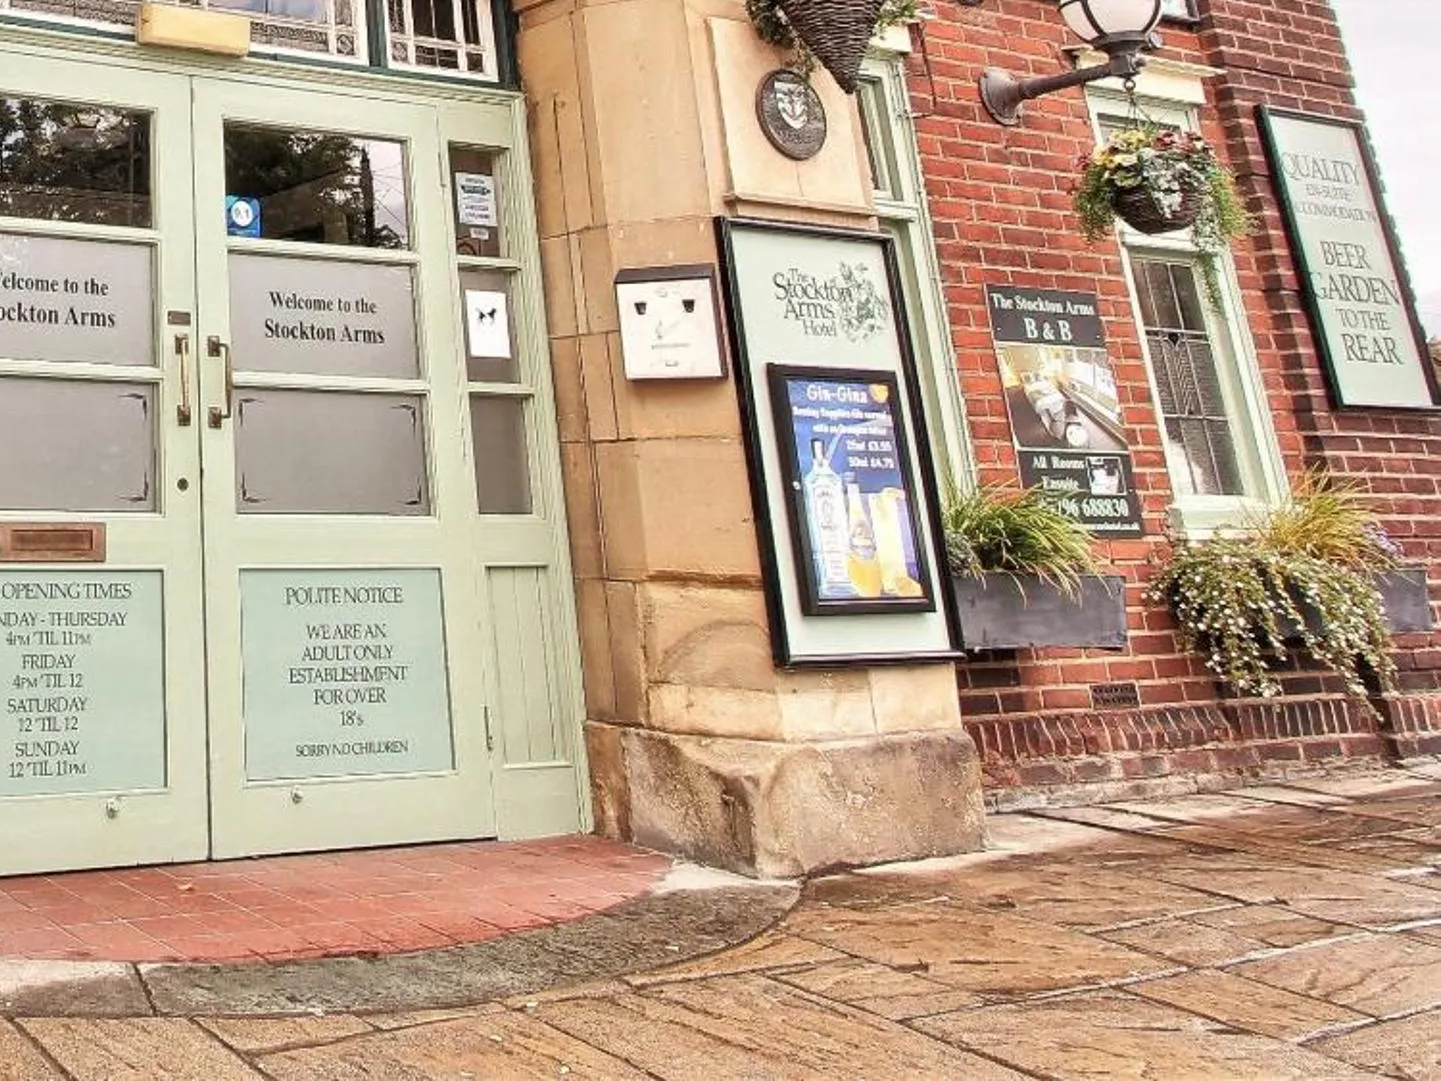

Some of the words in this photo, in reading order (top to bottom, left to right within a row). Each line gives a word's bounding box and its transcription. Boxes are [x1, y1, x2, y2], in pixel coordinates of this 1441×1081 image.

[1281, 152, 1360, 186] QUALITY
[1320, 240, 1372, 269] BEER
[788, 267, 808, 282] The
[63, 274, 78, 294] to
[84, 277, 109, 296] the
[772, 271, 854, 302] Stockton
[1310, 272, 1400, 306] GARDEN
[268, 291, 333, 312] Welcome
[337, 297, 352, 313] to
[355, 297, 377, 314] the
[784, 298, 836, 321] Arms
[990, 292, 1013, 309] The
[1014, 295, 1064, 313] Stockton
[1066, 300, 1096, 316] Arms
[64, 308, 116, 328] Arms
[1335, 308, 1358, 329] TO
[1357, 310, 1391, 331] THE
[264, 318, 335, 341] Stockton
[340, 324, 385, 345] Arms
[802, 319, 837, 337] Hotel
[1024, 317, 1038, 339] B
[1043, 322, 1056, 340] &
[1057, 319, 1073, 341] B
[1341, 333, 1405, 365] REAR
[1, 582, 80, 600] OPENING
[83, 583, 132, 599] TIMES
[285, 587, 341, 605] POLITE
[343, 586, 404, 604] NOTICE
[48, 611, 128, 627] THURSDAY
[306, 624, 331, 639] WE
[333, 623, 362, 639] ARE
[364, 623, 387, 639] AN
[22, 653, 76, 670] FRIDAY
[302, 644, 352, 661] ADULT
[353, 644, 393, 660] ONLY
[70, 673, 83, 688] 12
[288, 666, 409, 684] ESTABLISHMENT
[7, 696, 88, 714] SATURDAY
[313, 688, 344, 705] FOR
[346, 687, 387, 703] OVER
[18, 717, 32, 732] 12
[64, 716, 78, 731] 12
[15, 740, 80, 758] SUNDAY
[296, 743, 332, 757] SORRY
[332, 742, 351, 755] NO
[352, 740, 409, 755] CHILDREN
[9, 762, 24, 778] 12
